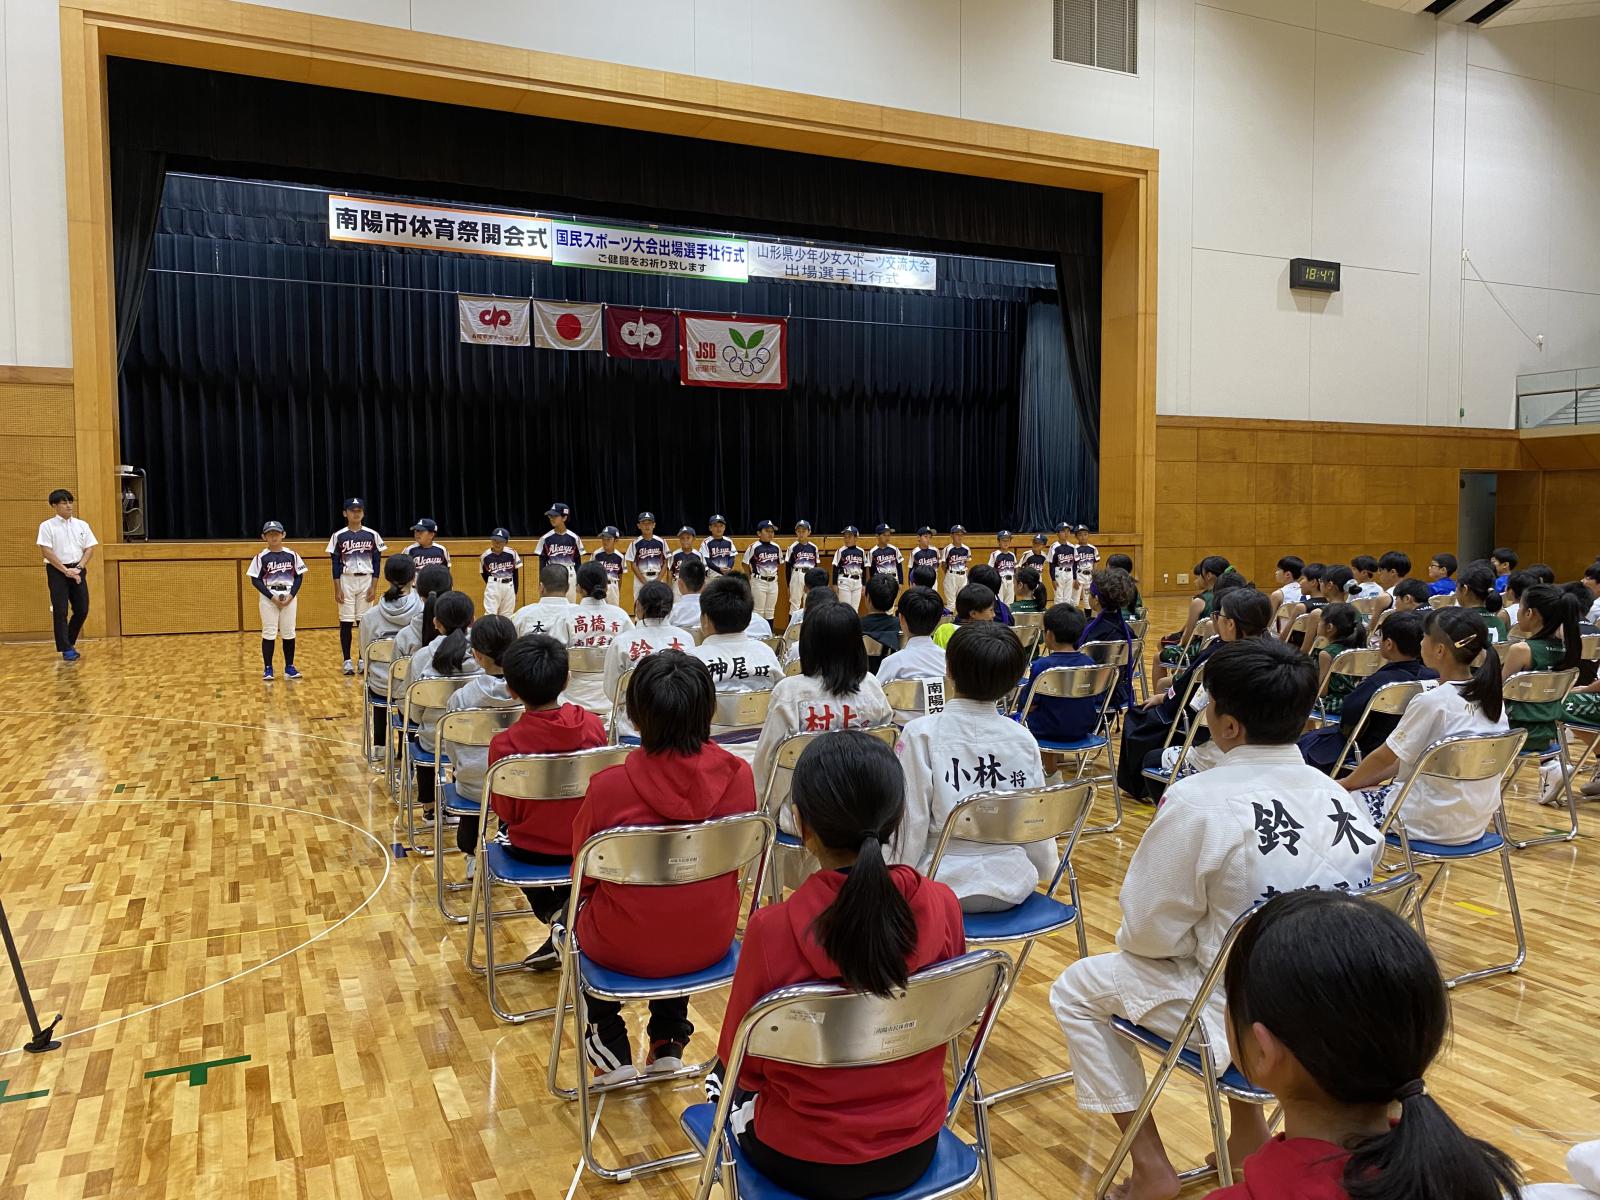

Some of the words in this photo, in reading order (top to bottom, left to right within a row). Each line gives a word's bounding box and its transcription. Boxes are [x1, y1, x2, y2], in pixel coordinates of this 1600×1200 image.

[335, 207, 548, 249] 南陽市体育祭開会式
[556, 229, 745, 263] 国民スポーツ大会出場選手壮行式
[598, 253, 707, 272] ご健闘をお祈り致します
[757, 245, 930, 273] 山形県少年少女スポーツ交流大会
[784, 264, 898, 285] 出場選手壮行式
[1305, 267, 1335, 282] 18:47
[341, 540, 374, 554] Akayu
[547, 544, 575, 557] Akayu
[267, 561, 294, 574] Akayu
[413, 556, 443, 569] Akayu
[488, 561, 514, 574] Akayu
[574, 615, 606, 634] 高橋
[707, 656, 750, 681] 神尾
[945, 753, 1007, 792] 小林
[1251, 798, 1377, 856] 鈴木
